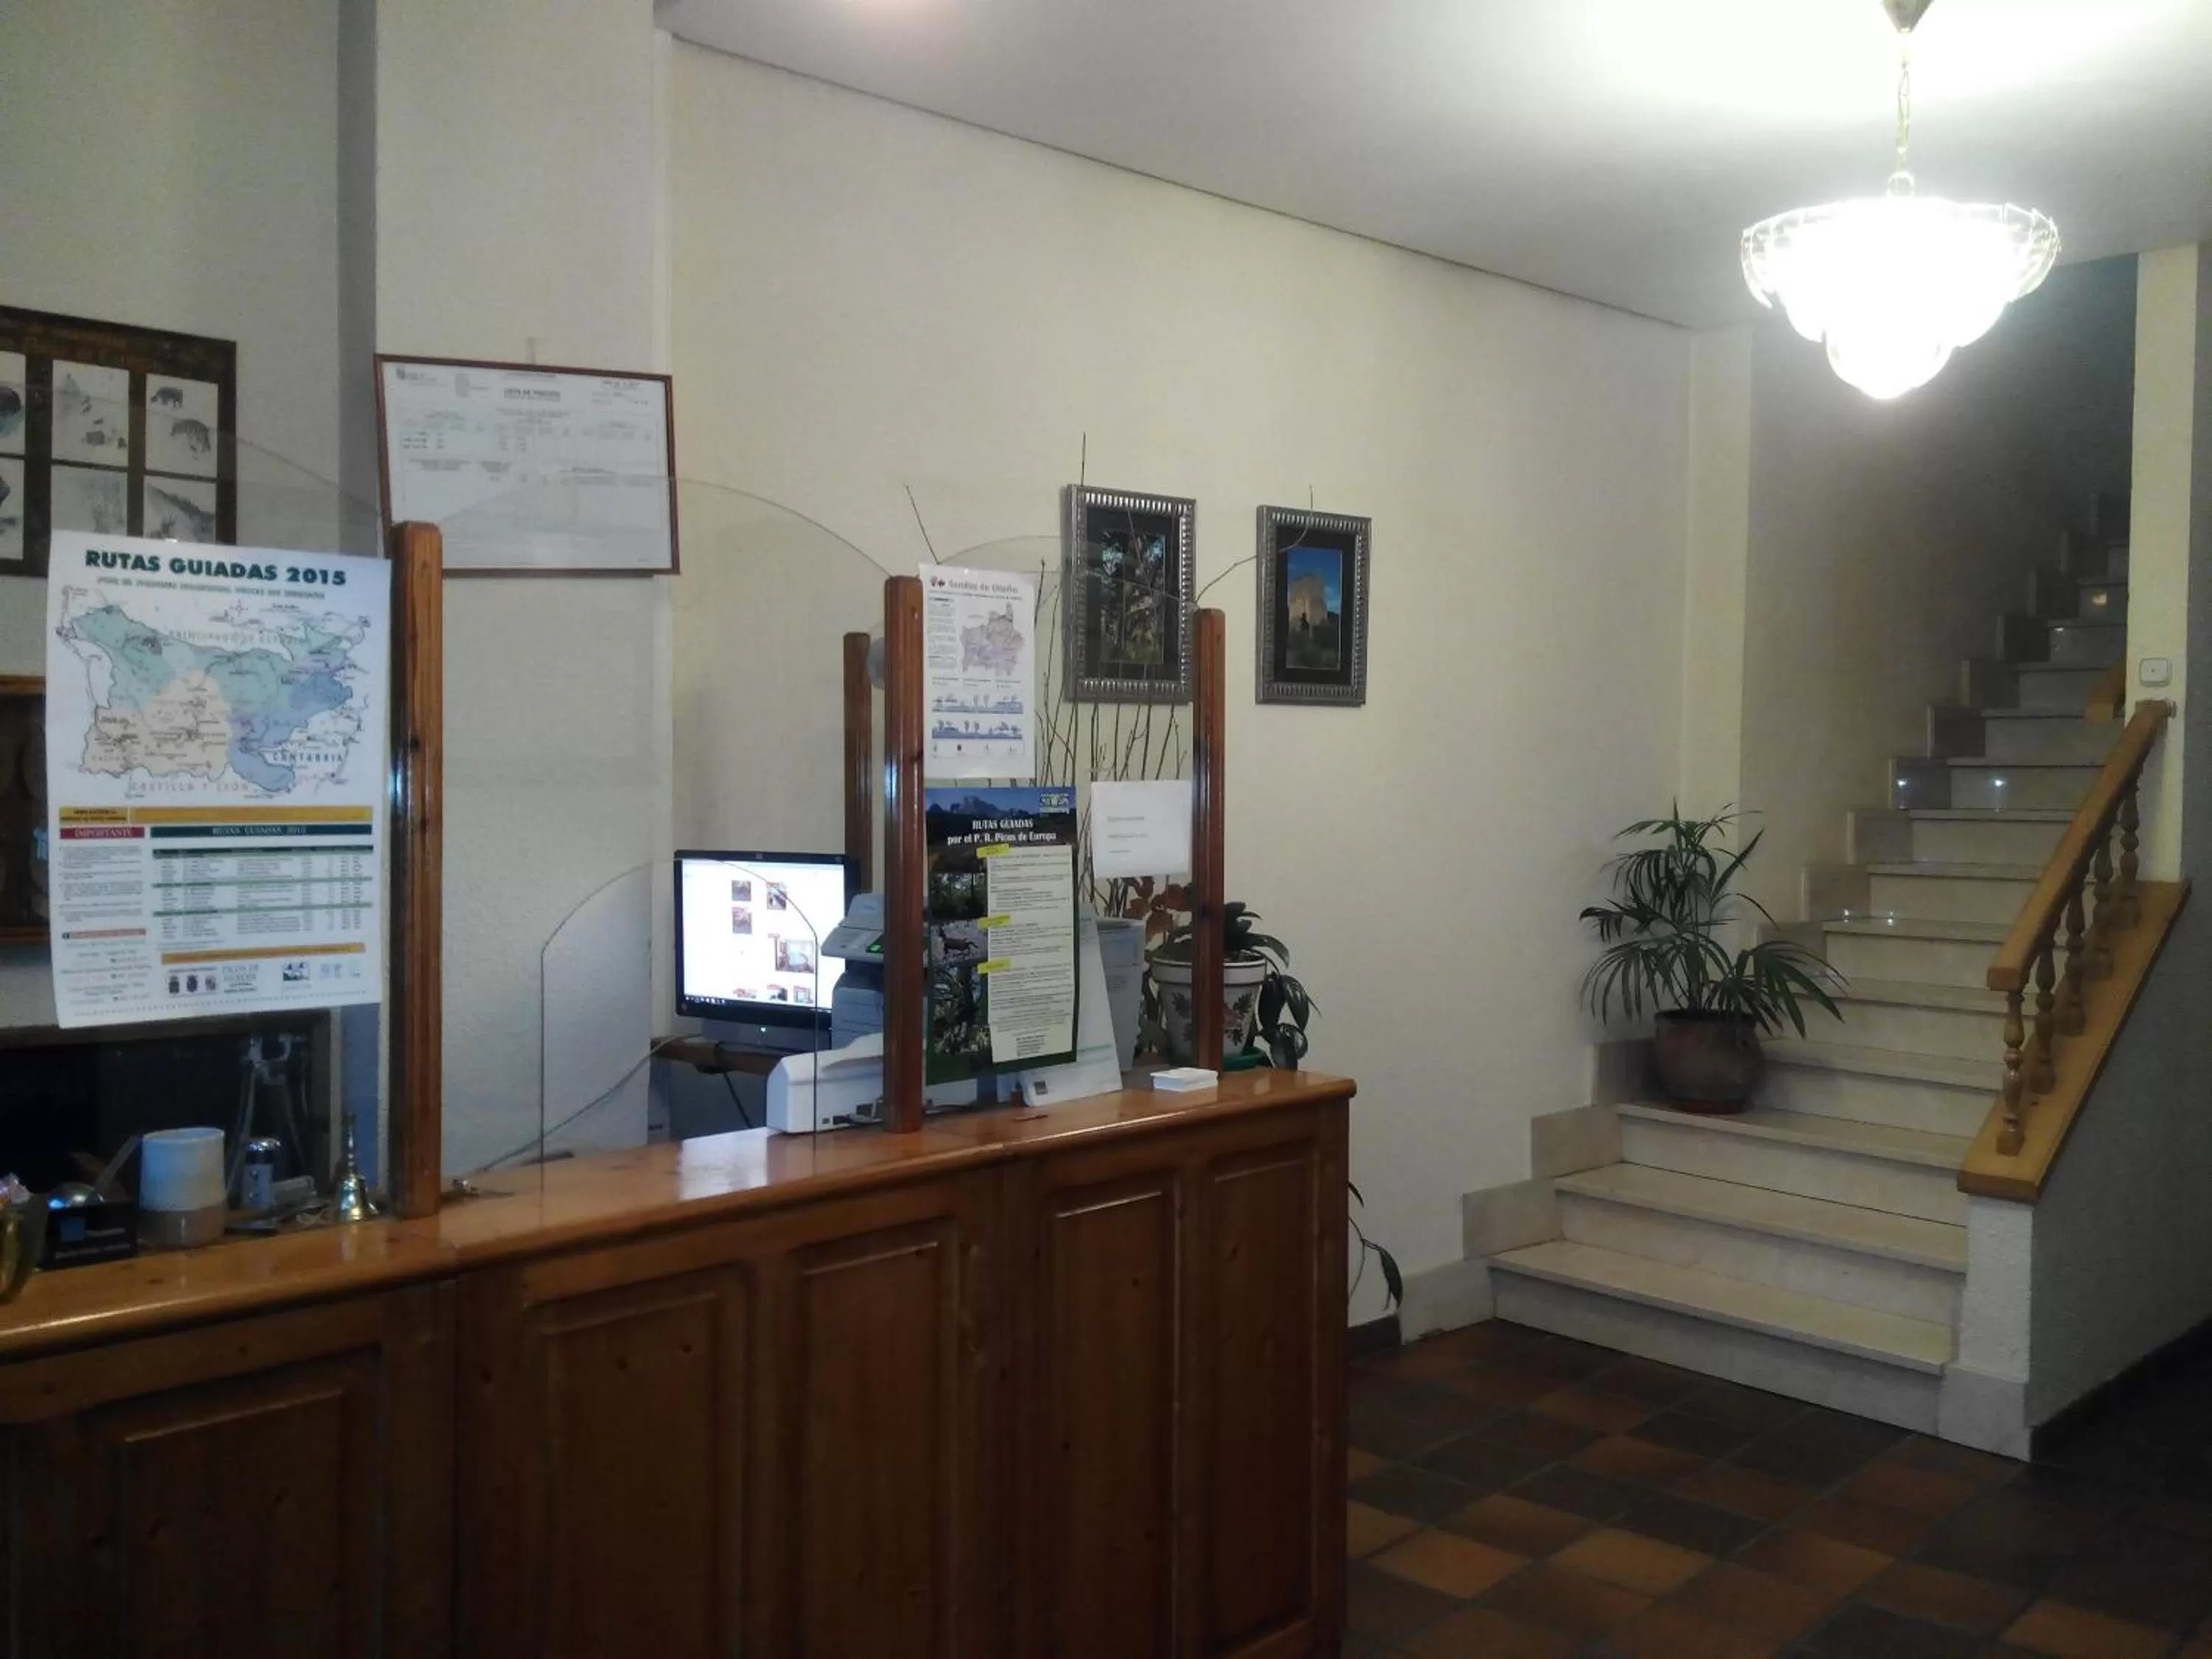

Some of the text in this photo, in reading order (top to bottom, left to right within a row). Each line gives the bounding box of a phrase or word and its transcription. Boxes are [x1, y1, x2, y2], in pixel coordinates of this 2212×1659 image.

[85, 549, 347, 585] RUTAS GUIADAS 2015
[972, 818, 1033, 830] RUTAS GUIADAS
[74, 827, 133, 838] IMPORTANTE
[947, 835, 962, 846] por
[964, 833, 972, 844] el
[995, 832, 1017, 842] Picos
[1018, 832, 1027, 841] de
[1029, 832, 1057, 842] Europa
